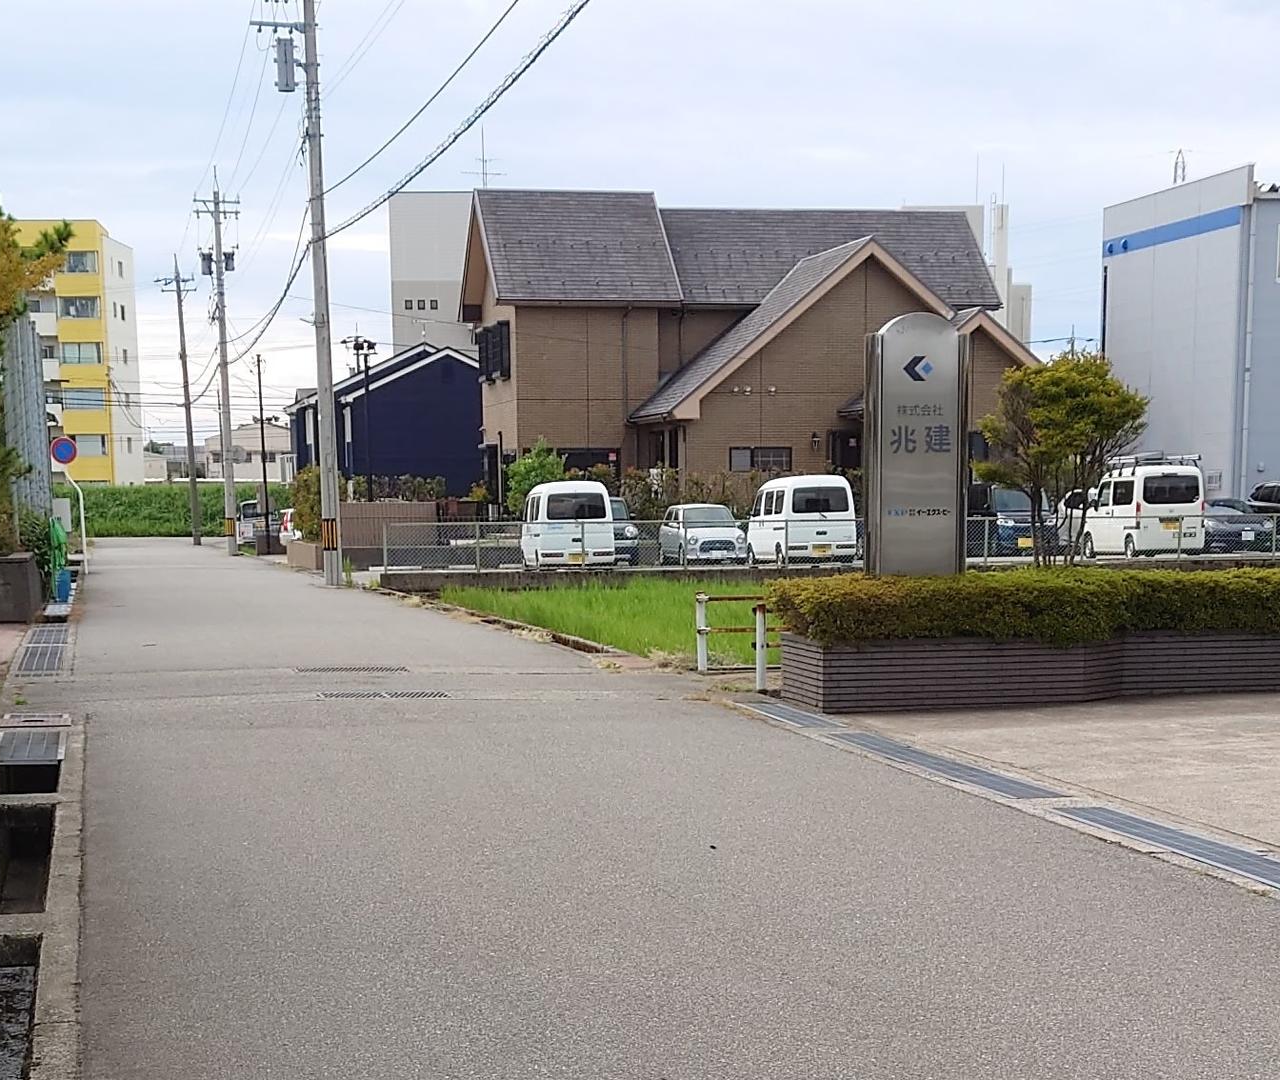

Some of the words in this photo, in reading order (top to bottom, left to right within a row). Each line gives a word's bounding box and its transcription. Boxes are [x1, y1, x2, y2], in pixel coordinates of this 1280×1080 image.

[897, 405, 944, 416] 株式会社
[890, 424, 951, 454] 兆建
